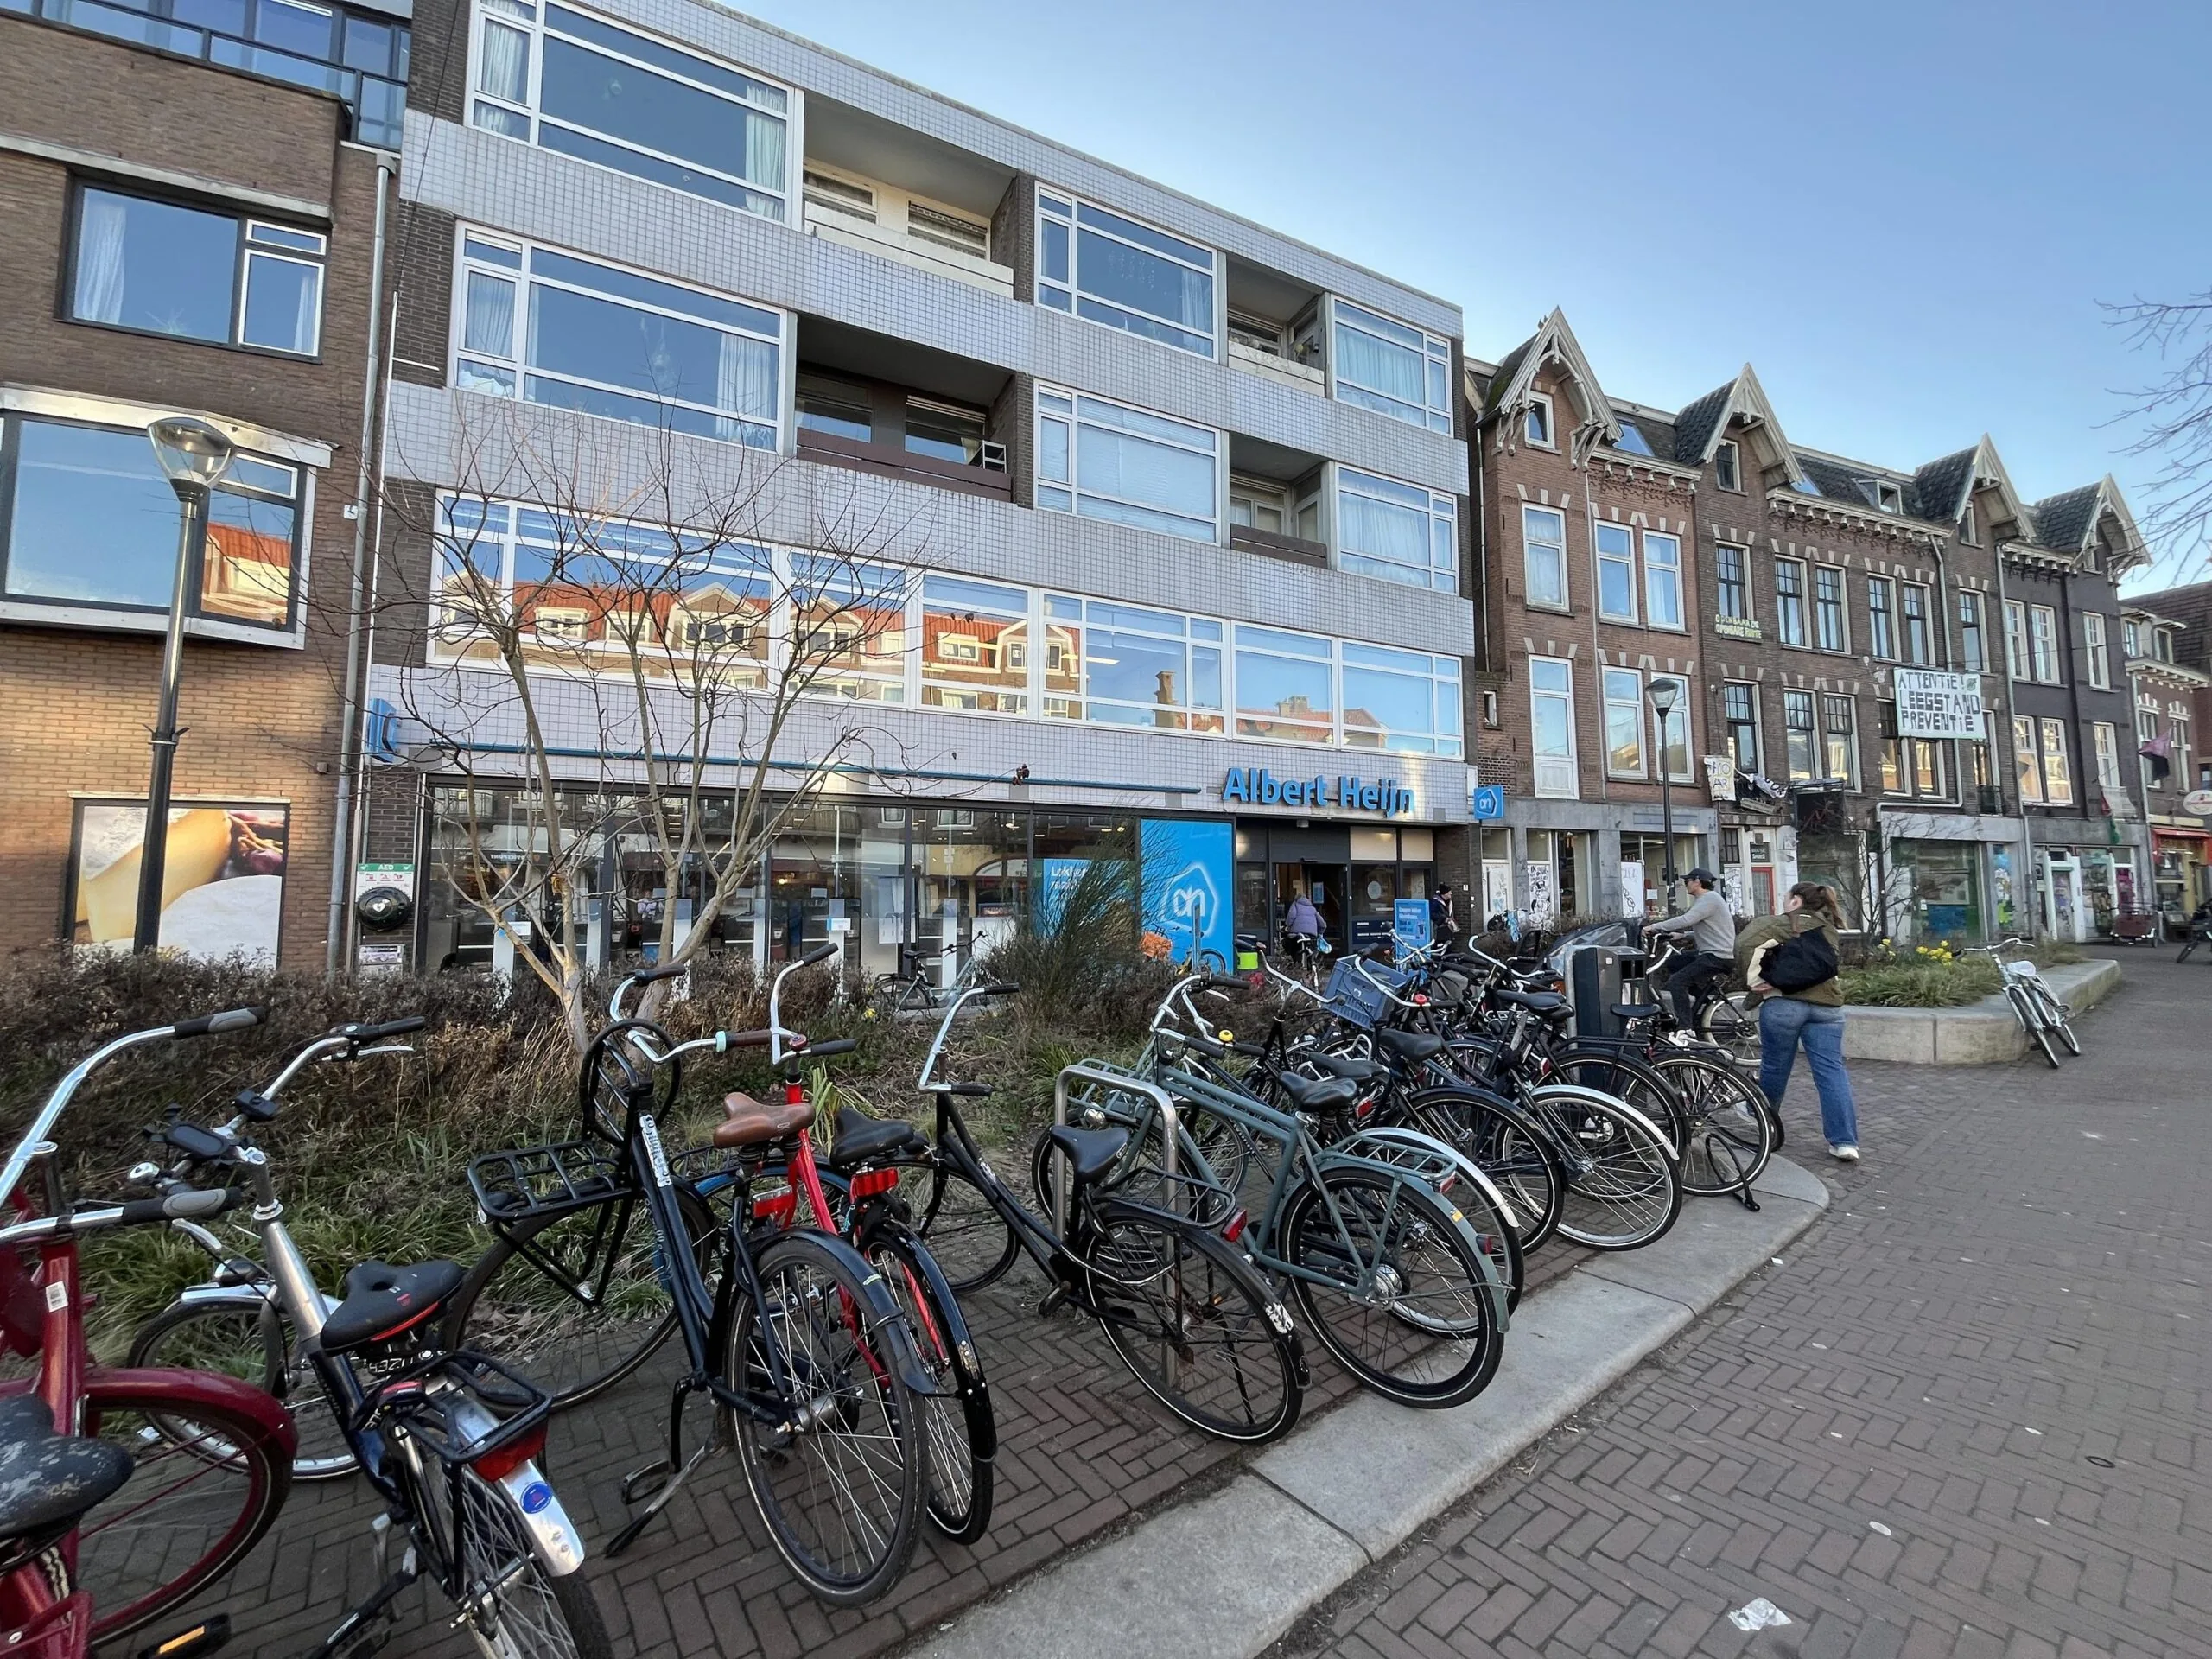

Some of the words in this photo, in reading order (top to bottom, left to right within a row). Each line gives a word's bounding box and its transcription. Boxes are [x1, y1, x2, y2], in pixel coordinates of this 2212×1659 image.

[1899, 690, 1981, 715] LEEGSTAND
[1223, 767, 1328, 807] Albert
[1338, 775, 1415, 819] Heijn
